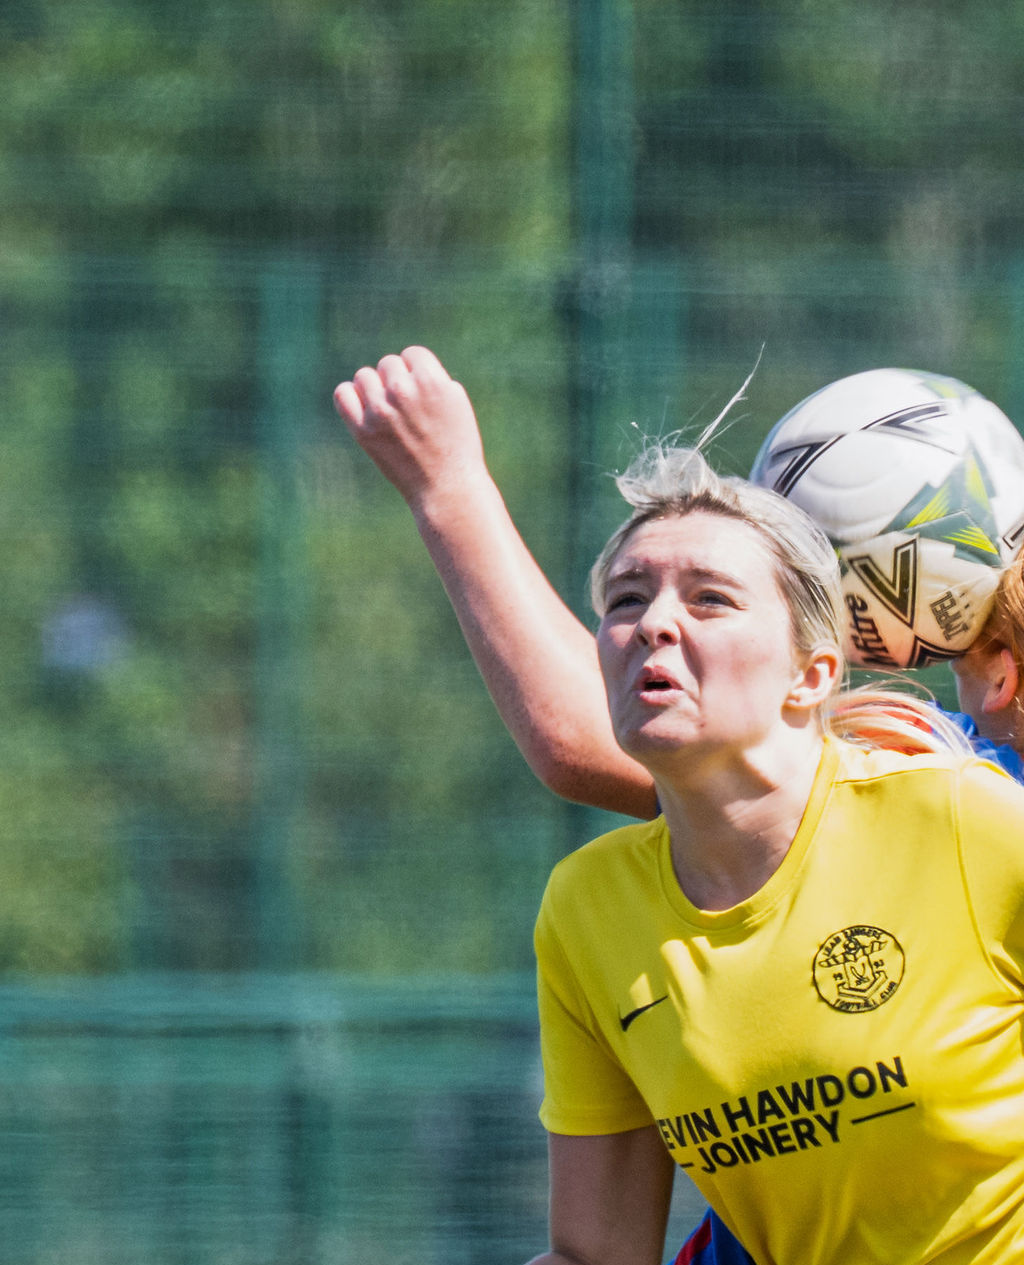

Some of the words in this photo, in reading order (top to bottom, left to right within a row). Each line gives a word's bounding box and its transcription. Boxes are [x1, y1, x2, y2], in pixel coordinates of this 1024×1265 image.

[657, 1108, 721, 1150] EVIN
[721, 1056, 908, 1133] HAWDON
[698, 1110, 841, 1174] JOINERY
